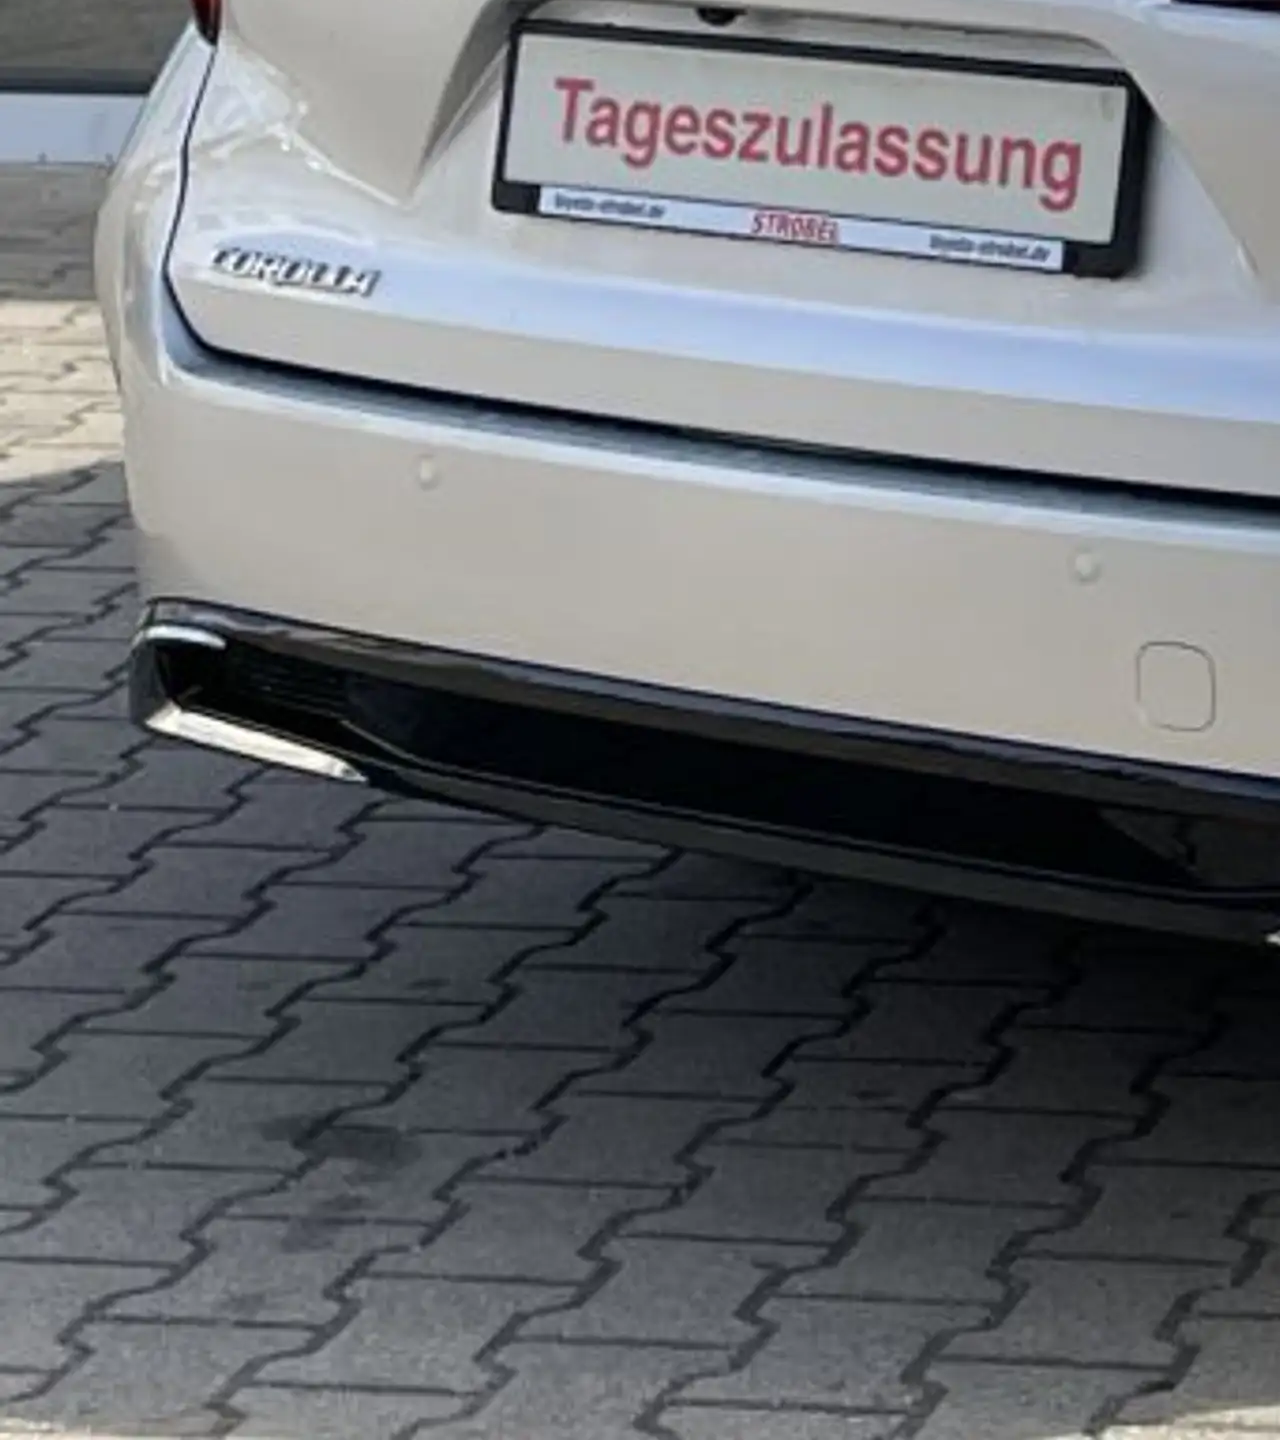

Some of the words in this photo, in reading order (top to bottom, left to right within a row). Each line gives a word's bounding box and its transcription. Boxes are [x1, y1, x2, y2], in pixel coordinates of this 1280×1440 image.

[554, 77, 1083, 213] Tageszulassung
[751, 210, 840, 245] STROBEL
[212, 247, 384, 299] COROLLA
